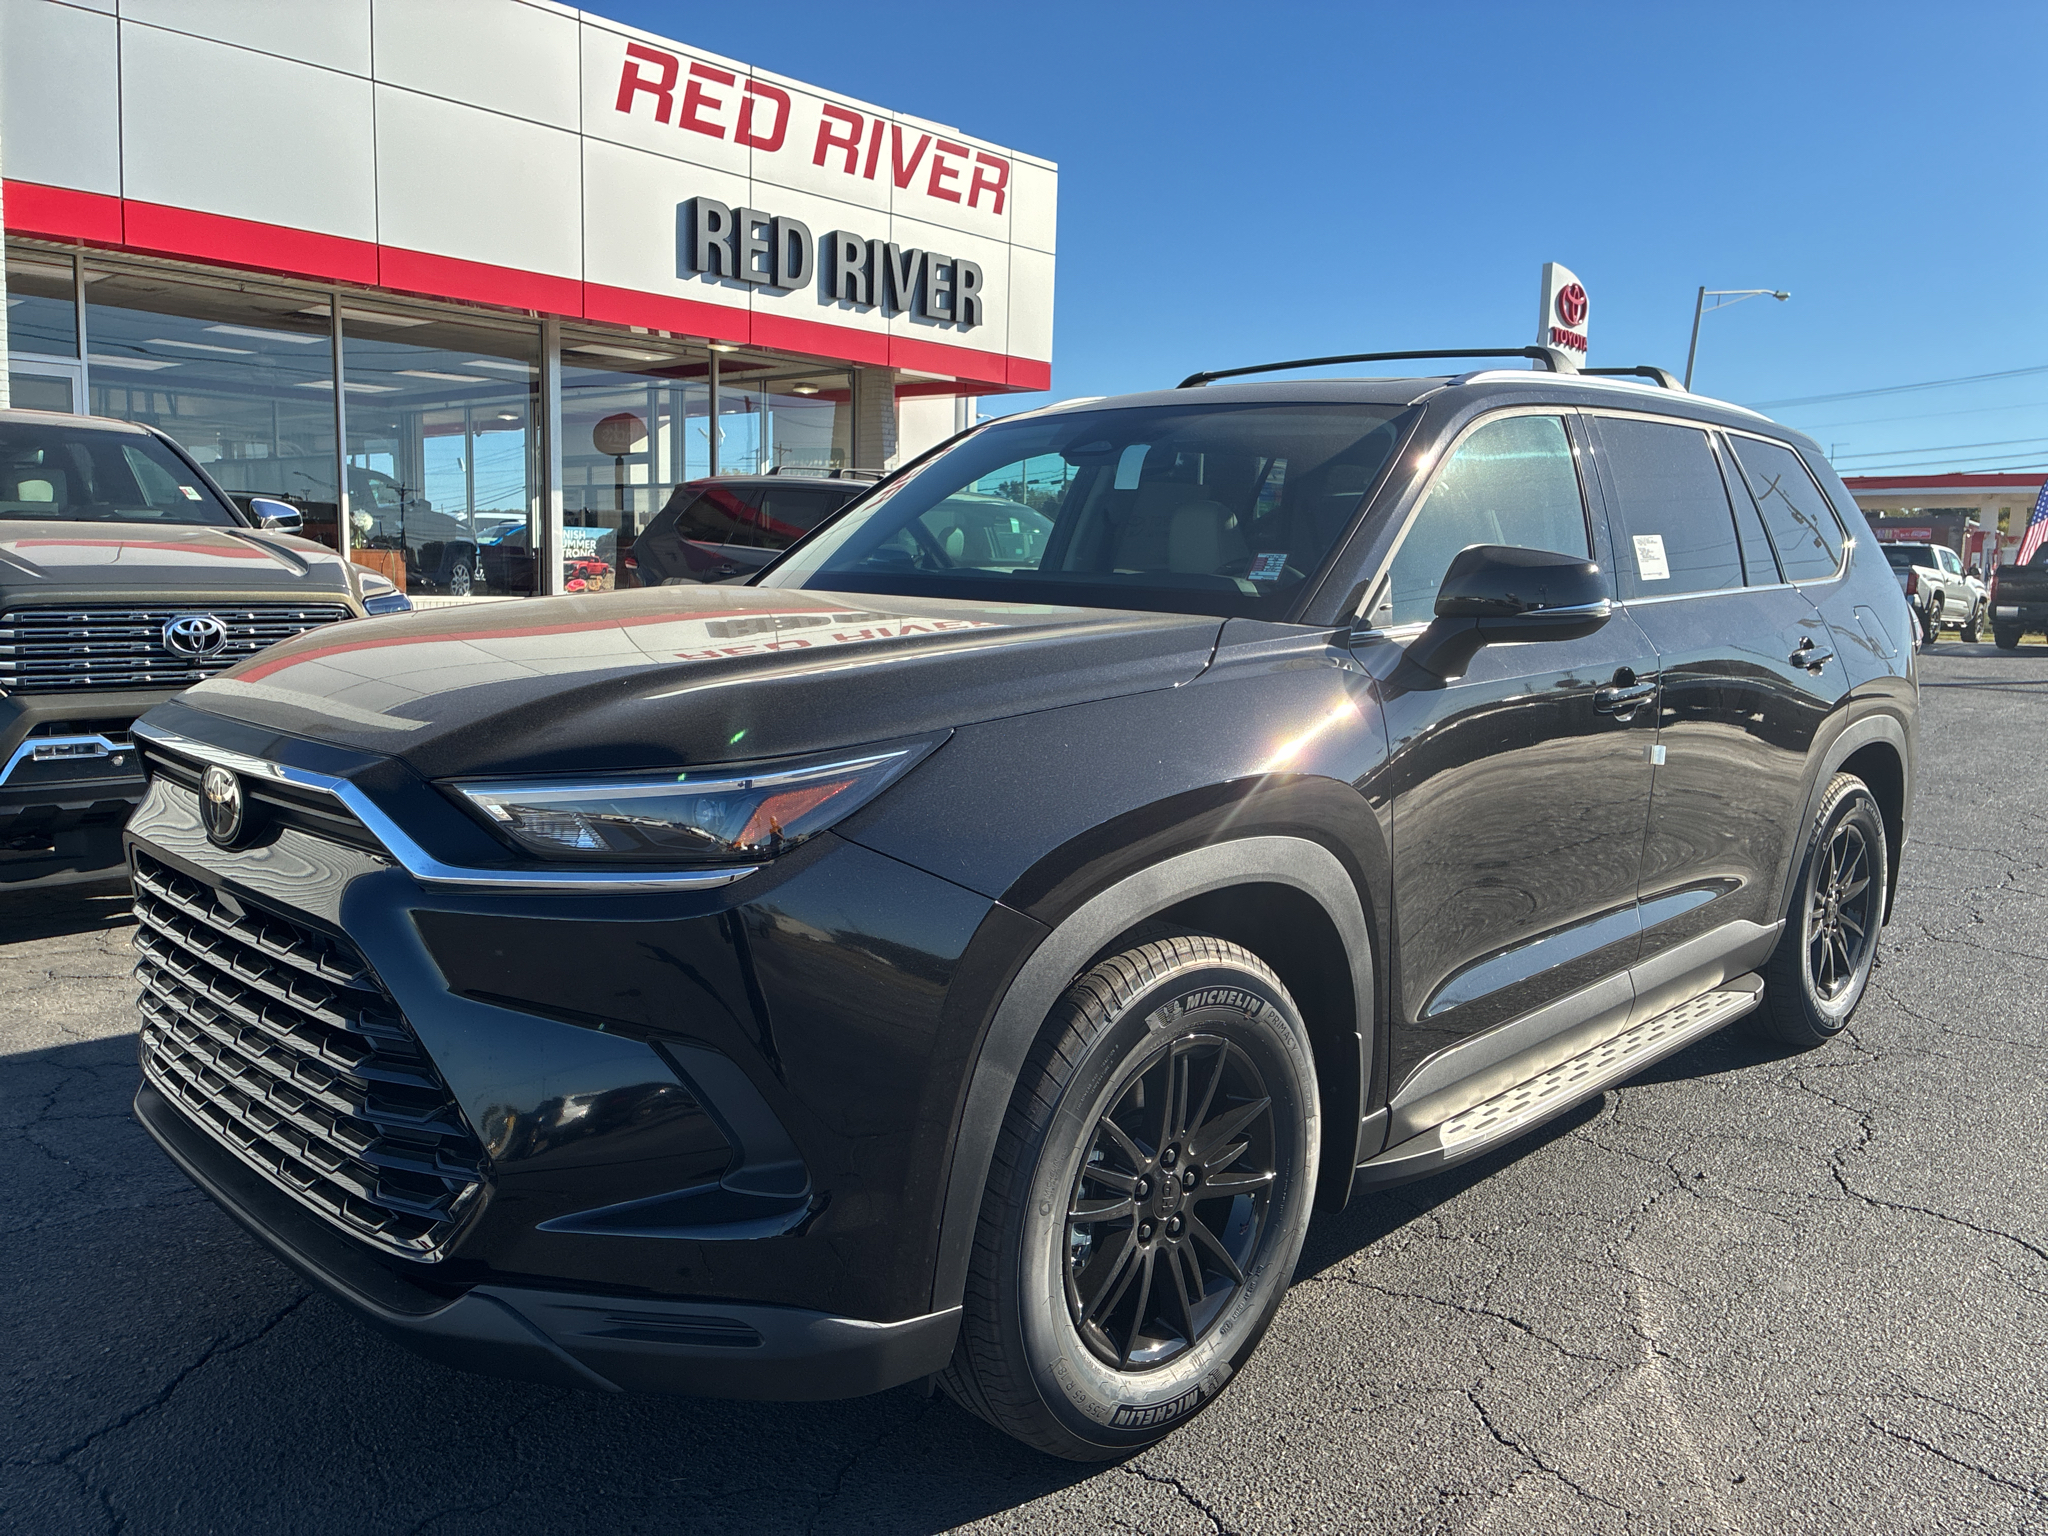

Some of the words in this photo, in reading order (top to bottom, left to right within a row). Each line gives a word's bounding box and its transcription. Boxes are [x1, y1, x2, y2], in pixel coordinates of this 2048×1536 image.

[615, 41, 791, 153] RED
[812, 103, 1011, 215] RIVER
[690, 196, 813, 292] RED
[832, 229, 983, 327] RIVER
[1553, 327, 1587, 351] TOYOTA
[562, 540, 596, 549] UMMER
[563, 530, 586, 539] NISH
[562, 549, 595, 558] TRONG
[1185, 990, 1261, 1014] MICHELIN
[1268, 1010, 1298, 1051] PRIMACY
[1057, 1366, 1070, 1382] 18
[1065, 1383, 1077, 1392] R
[1114, 1389, 1199, 1426] MICHELIN
